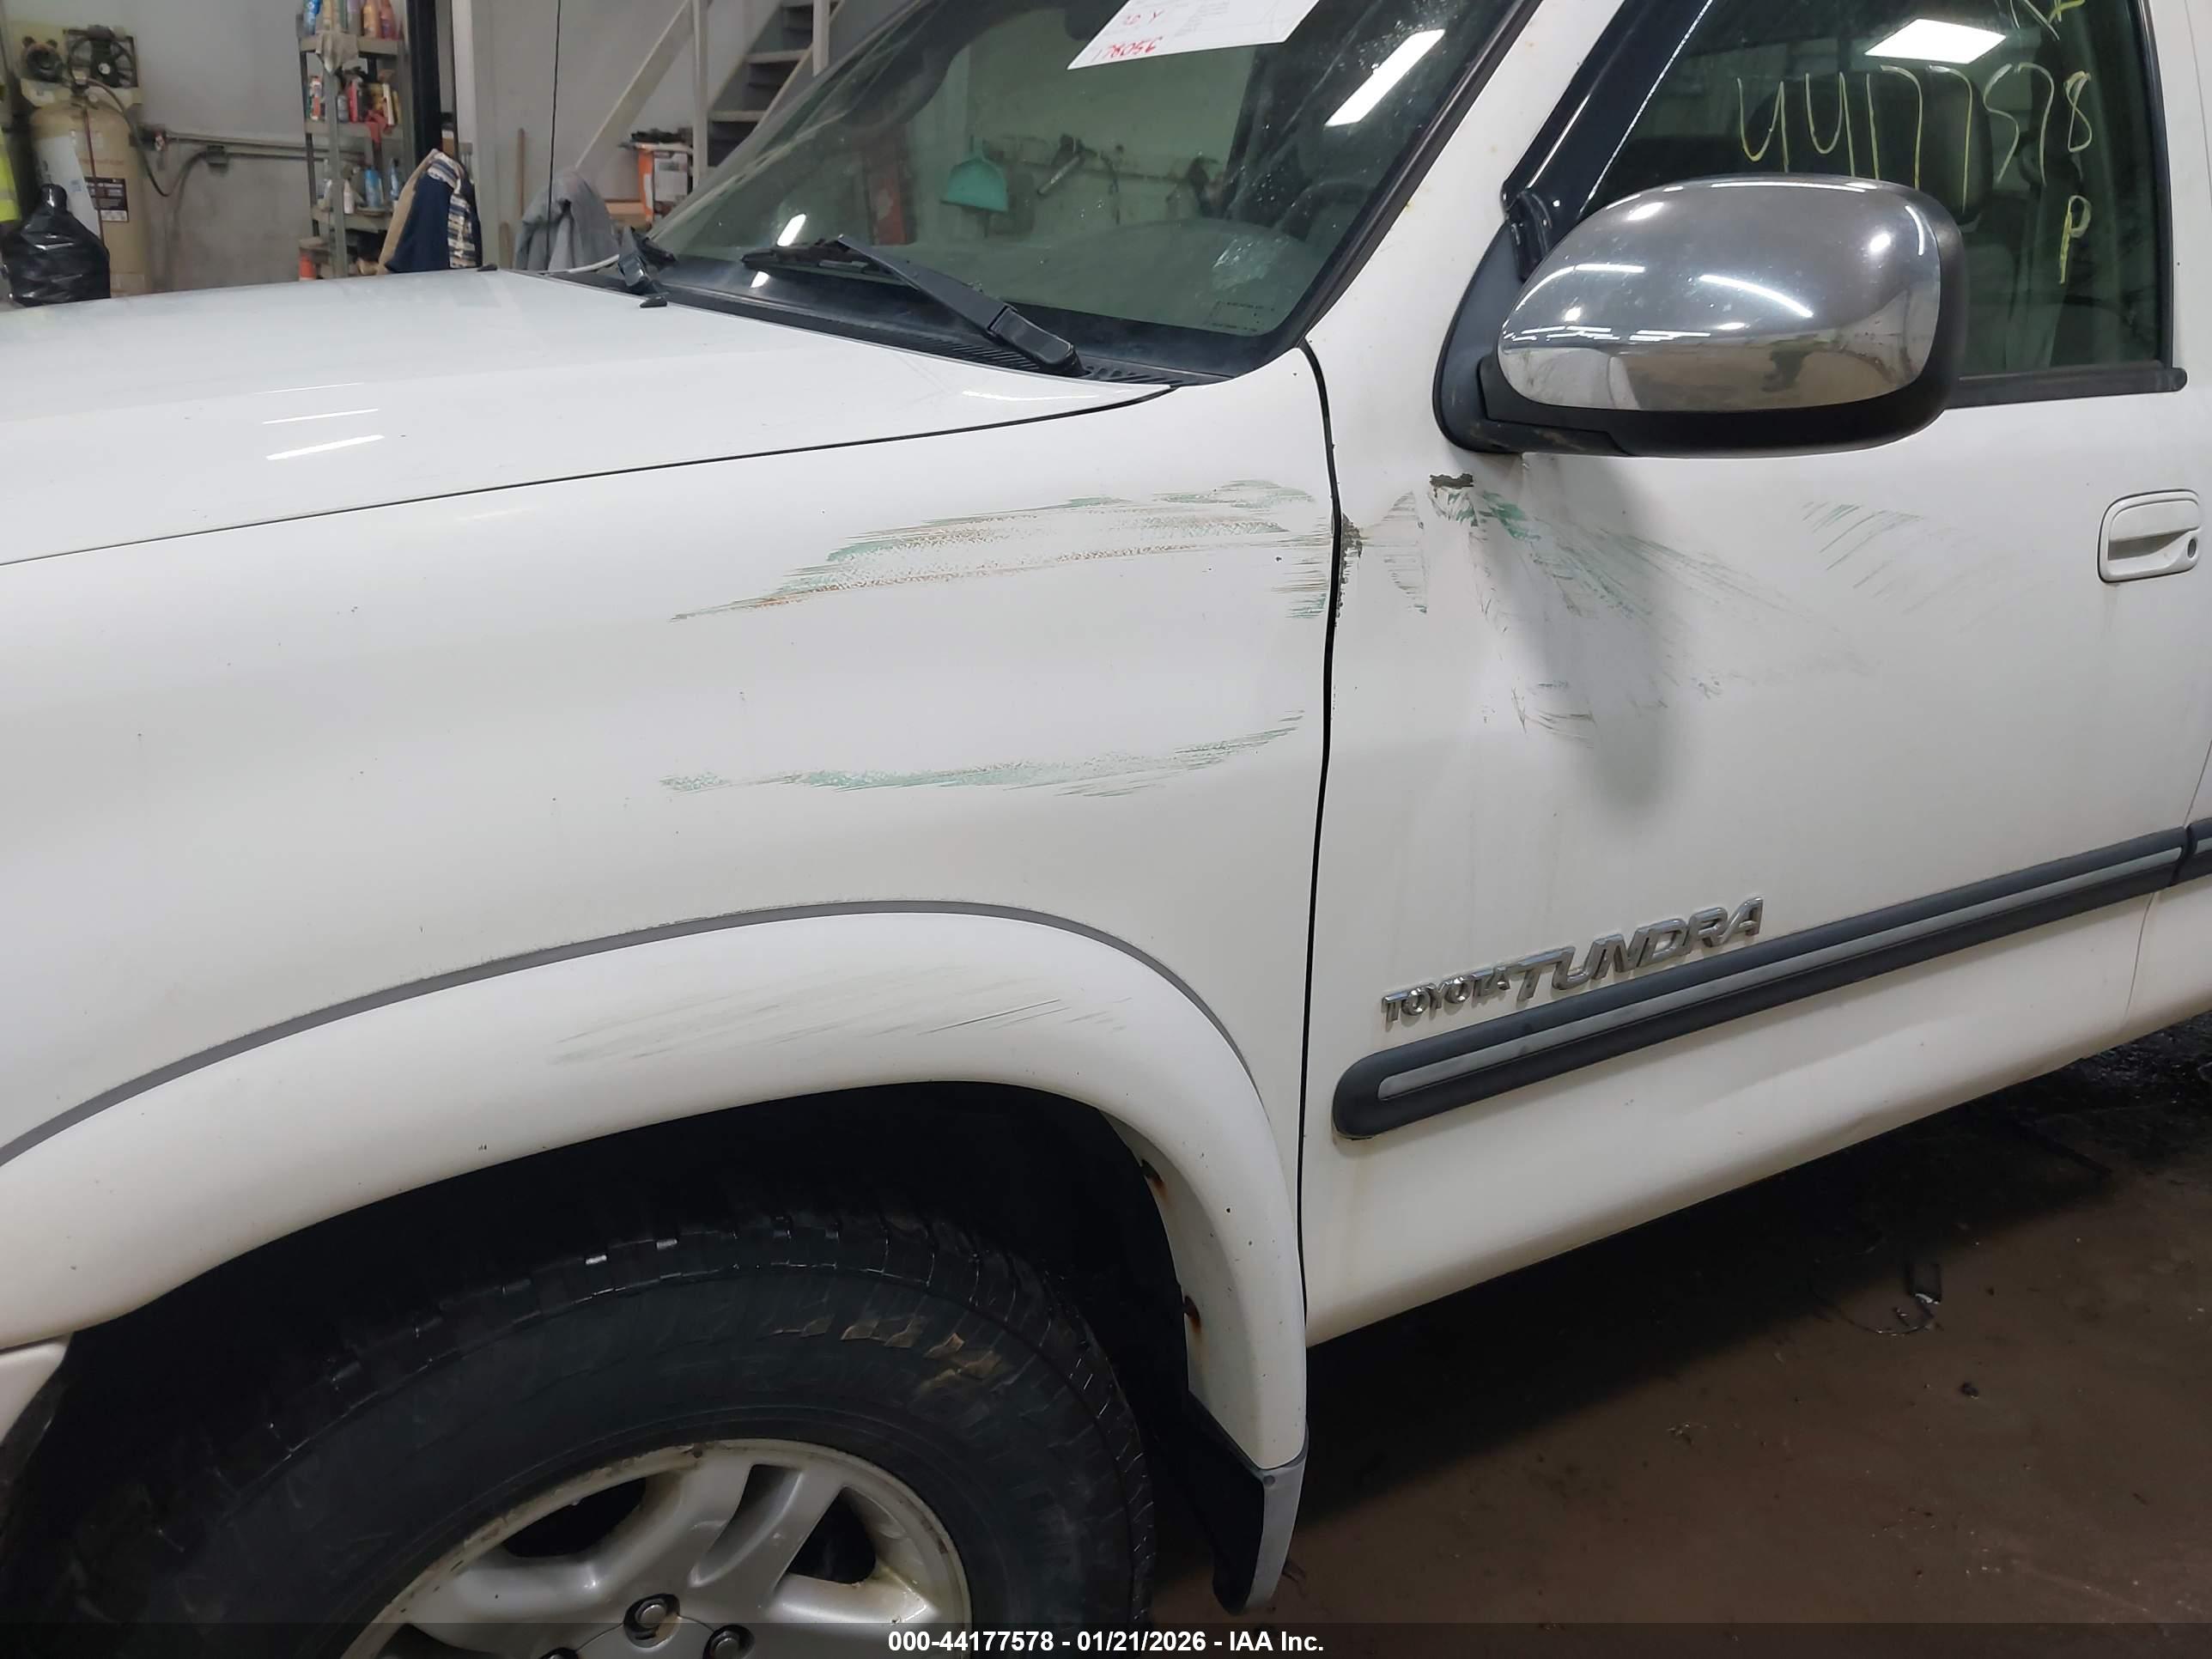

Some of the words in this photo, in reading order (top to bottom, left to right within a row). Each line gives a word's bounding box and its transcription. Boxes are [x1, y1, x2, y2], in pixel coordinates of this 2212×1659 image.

[2058, 194, 2092, 284] P
[1381, 963, 1510, 1024] TOYOTA
[1509, 896, 1764, 1005] TUNDRA
